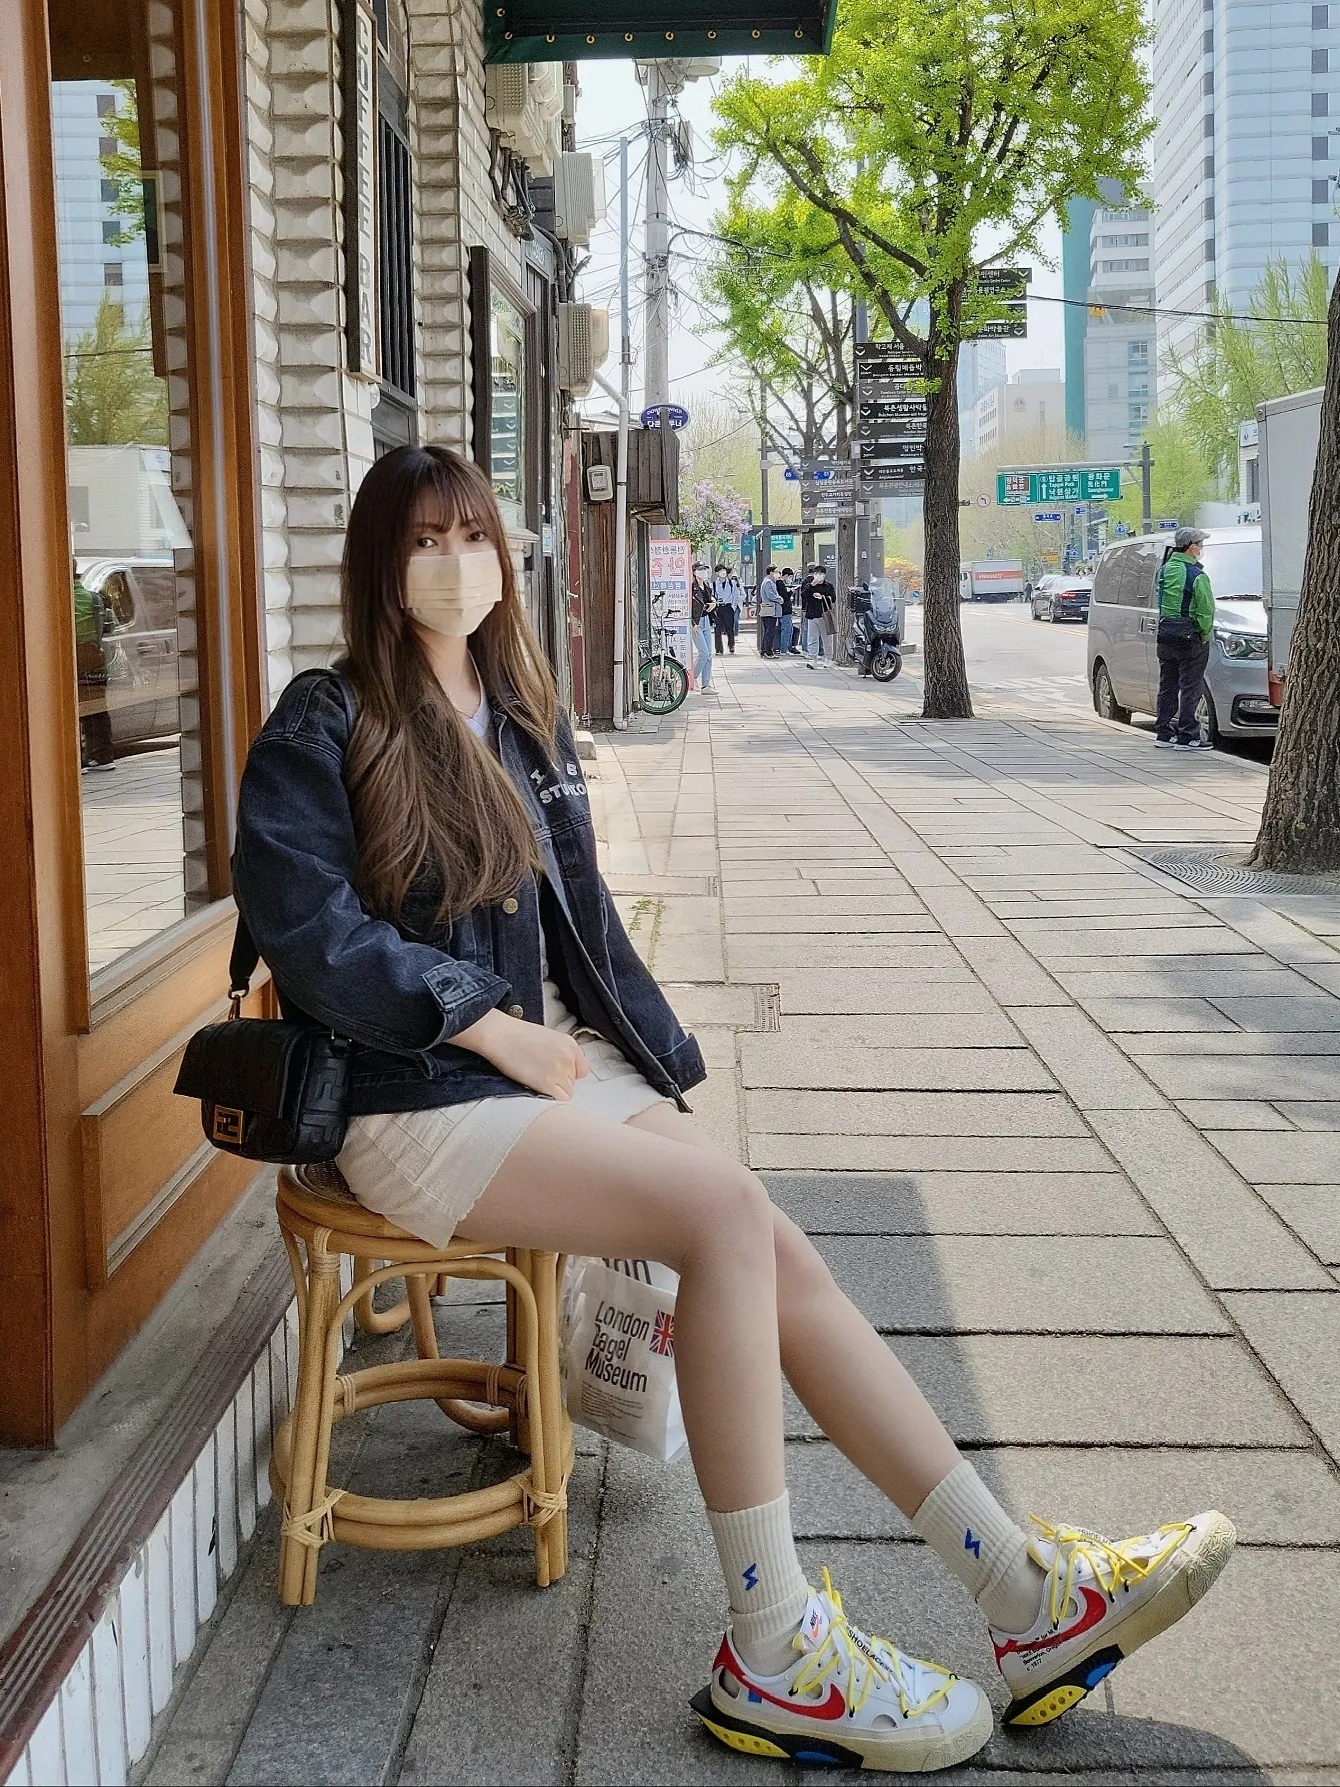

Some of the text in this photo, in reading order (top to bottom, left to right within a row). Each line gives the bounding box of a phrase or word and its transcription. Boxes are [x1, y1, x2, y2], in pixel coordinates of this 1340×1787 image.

[356, 14, 373, 366] COFFEE BAR
[903, 444, 924, 452] 명인박
[1087, 472, 1111, 481] 광화문
[595, 1300, 650, 1341] London
[585, 1347, 648, 1393] Museum
